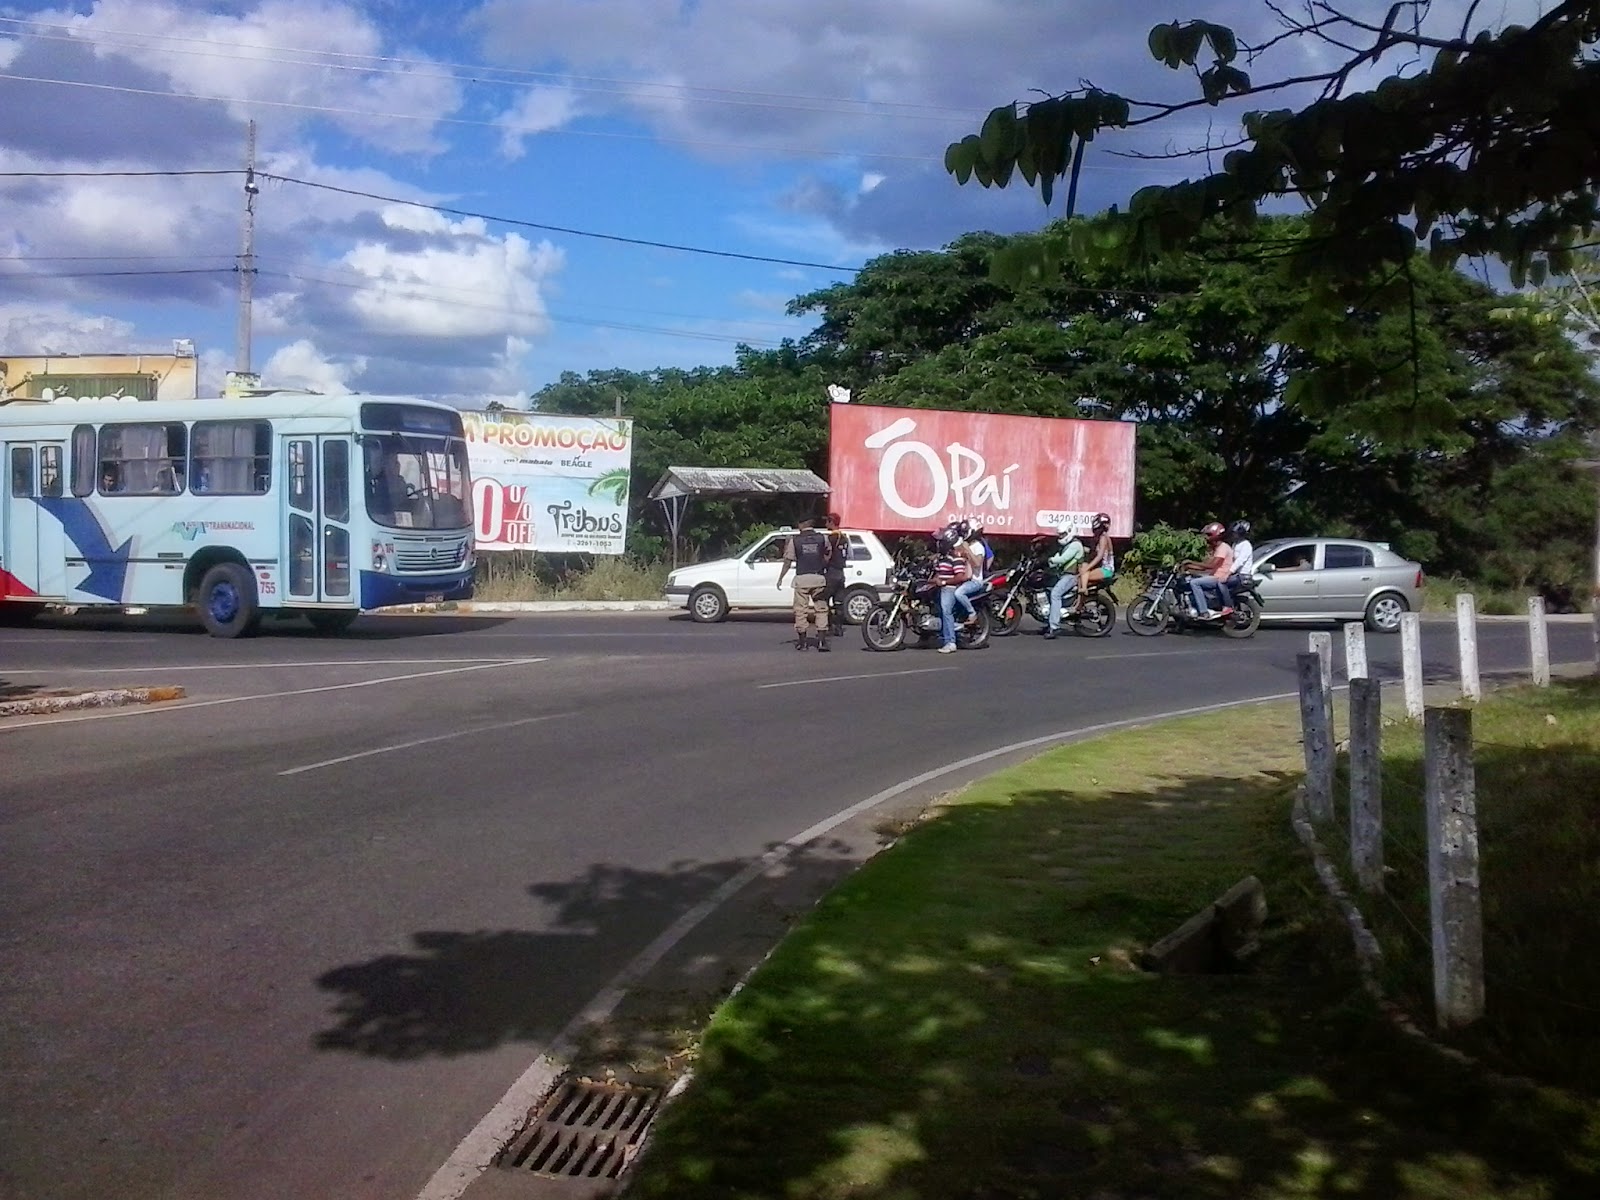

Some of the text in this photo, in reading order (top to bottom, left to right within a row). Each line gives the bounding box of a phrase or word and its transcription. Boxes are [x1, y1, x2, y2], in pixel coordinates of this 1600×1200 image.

[483, 423, 627, 454] PROMOÇÃO
[560, 459, 592, 468] BEAGLE
[547, 500, 623, 535] Tribus
[507, 522, 536, 544] OFF
[260, 581, 276, 594] 755
